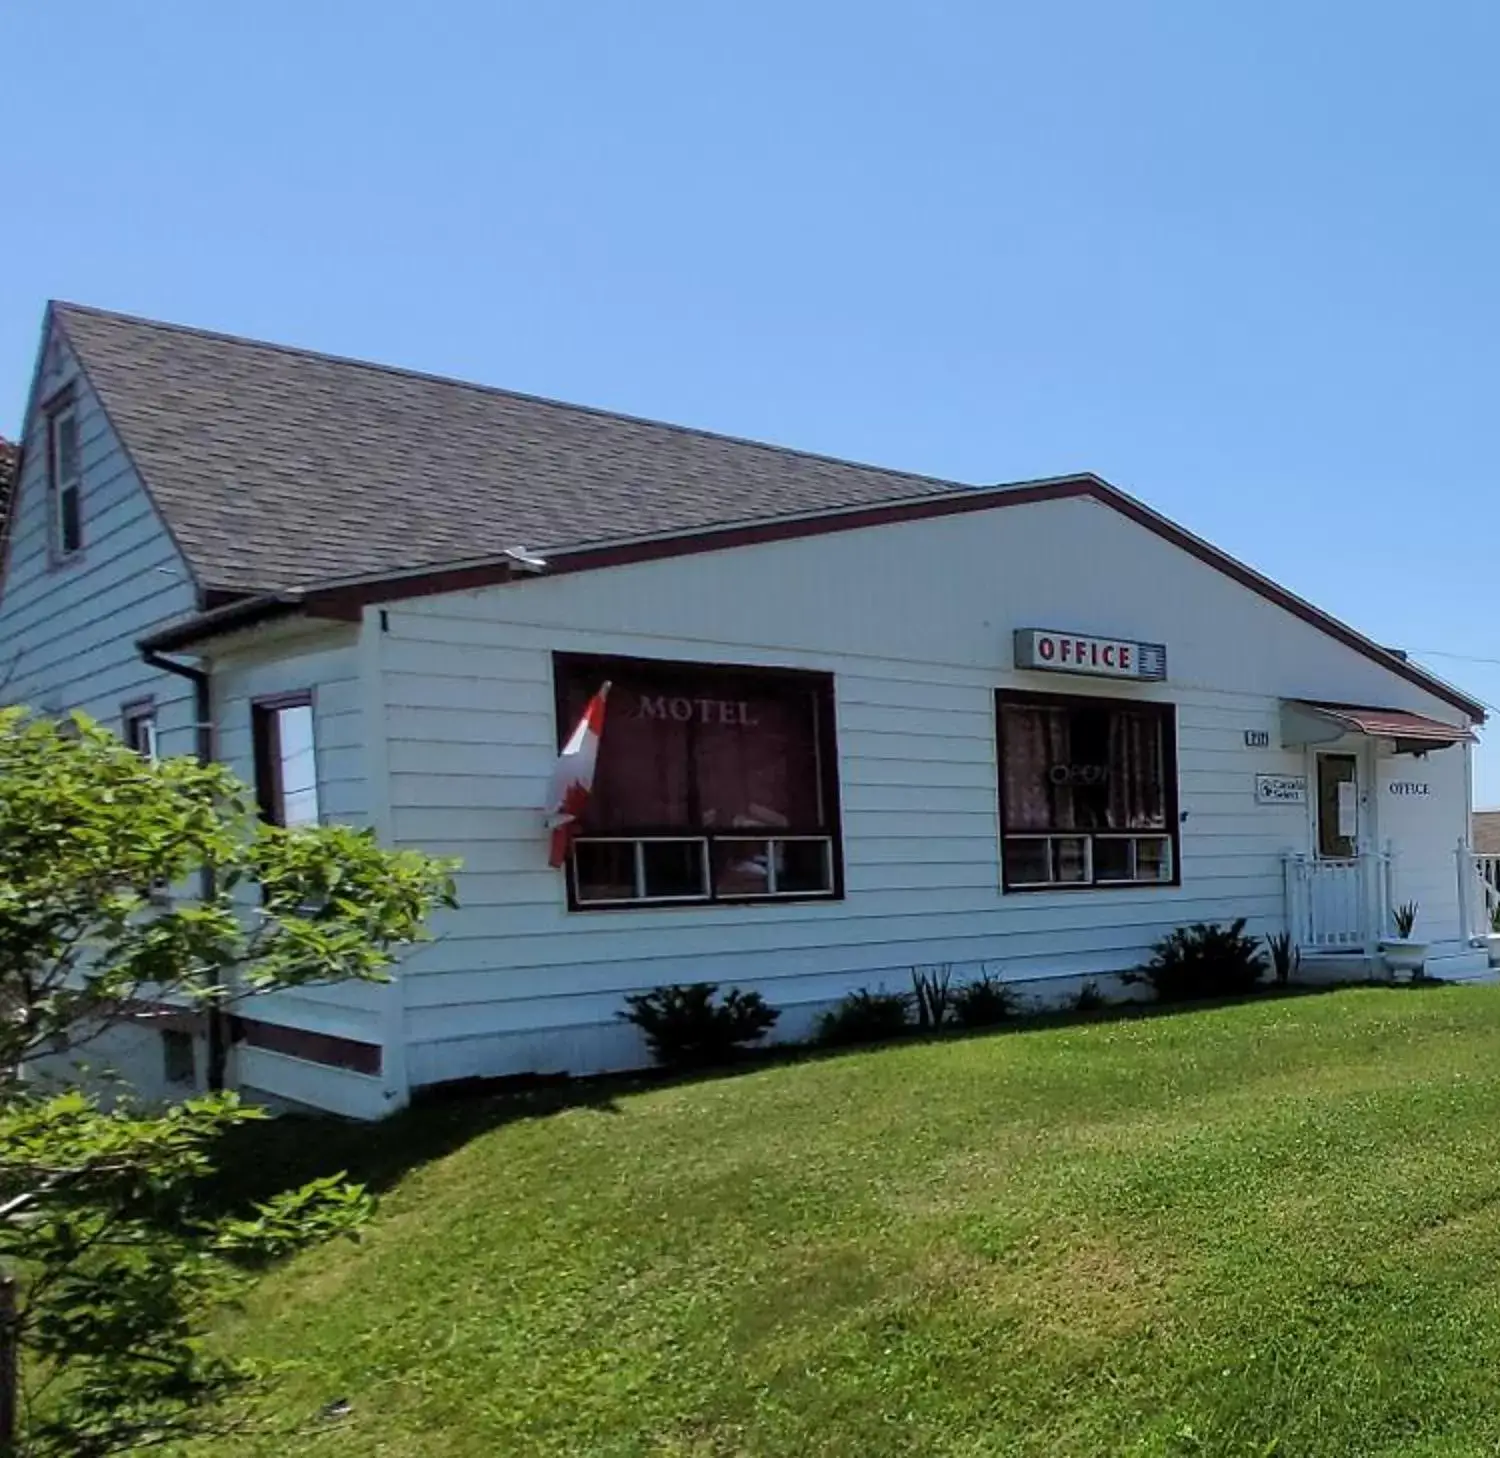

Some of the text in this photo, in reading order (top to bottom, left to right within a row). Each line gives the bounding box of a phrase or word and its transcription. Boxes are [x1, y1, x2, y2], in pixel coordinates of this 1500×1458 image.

[1038, 637, 1131, 669] OFFICE
[638, 695, 759, 726] MOTEL
[1389, 782, 1431, 796] OFFICE
